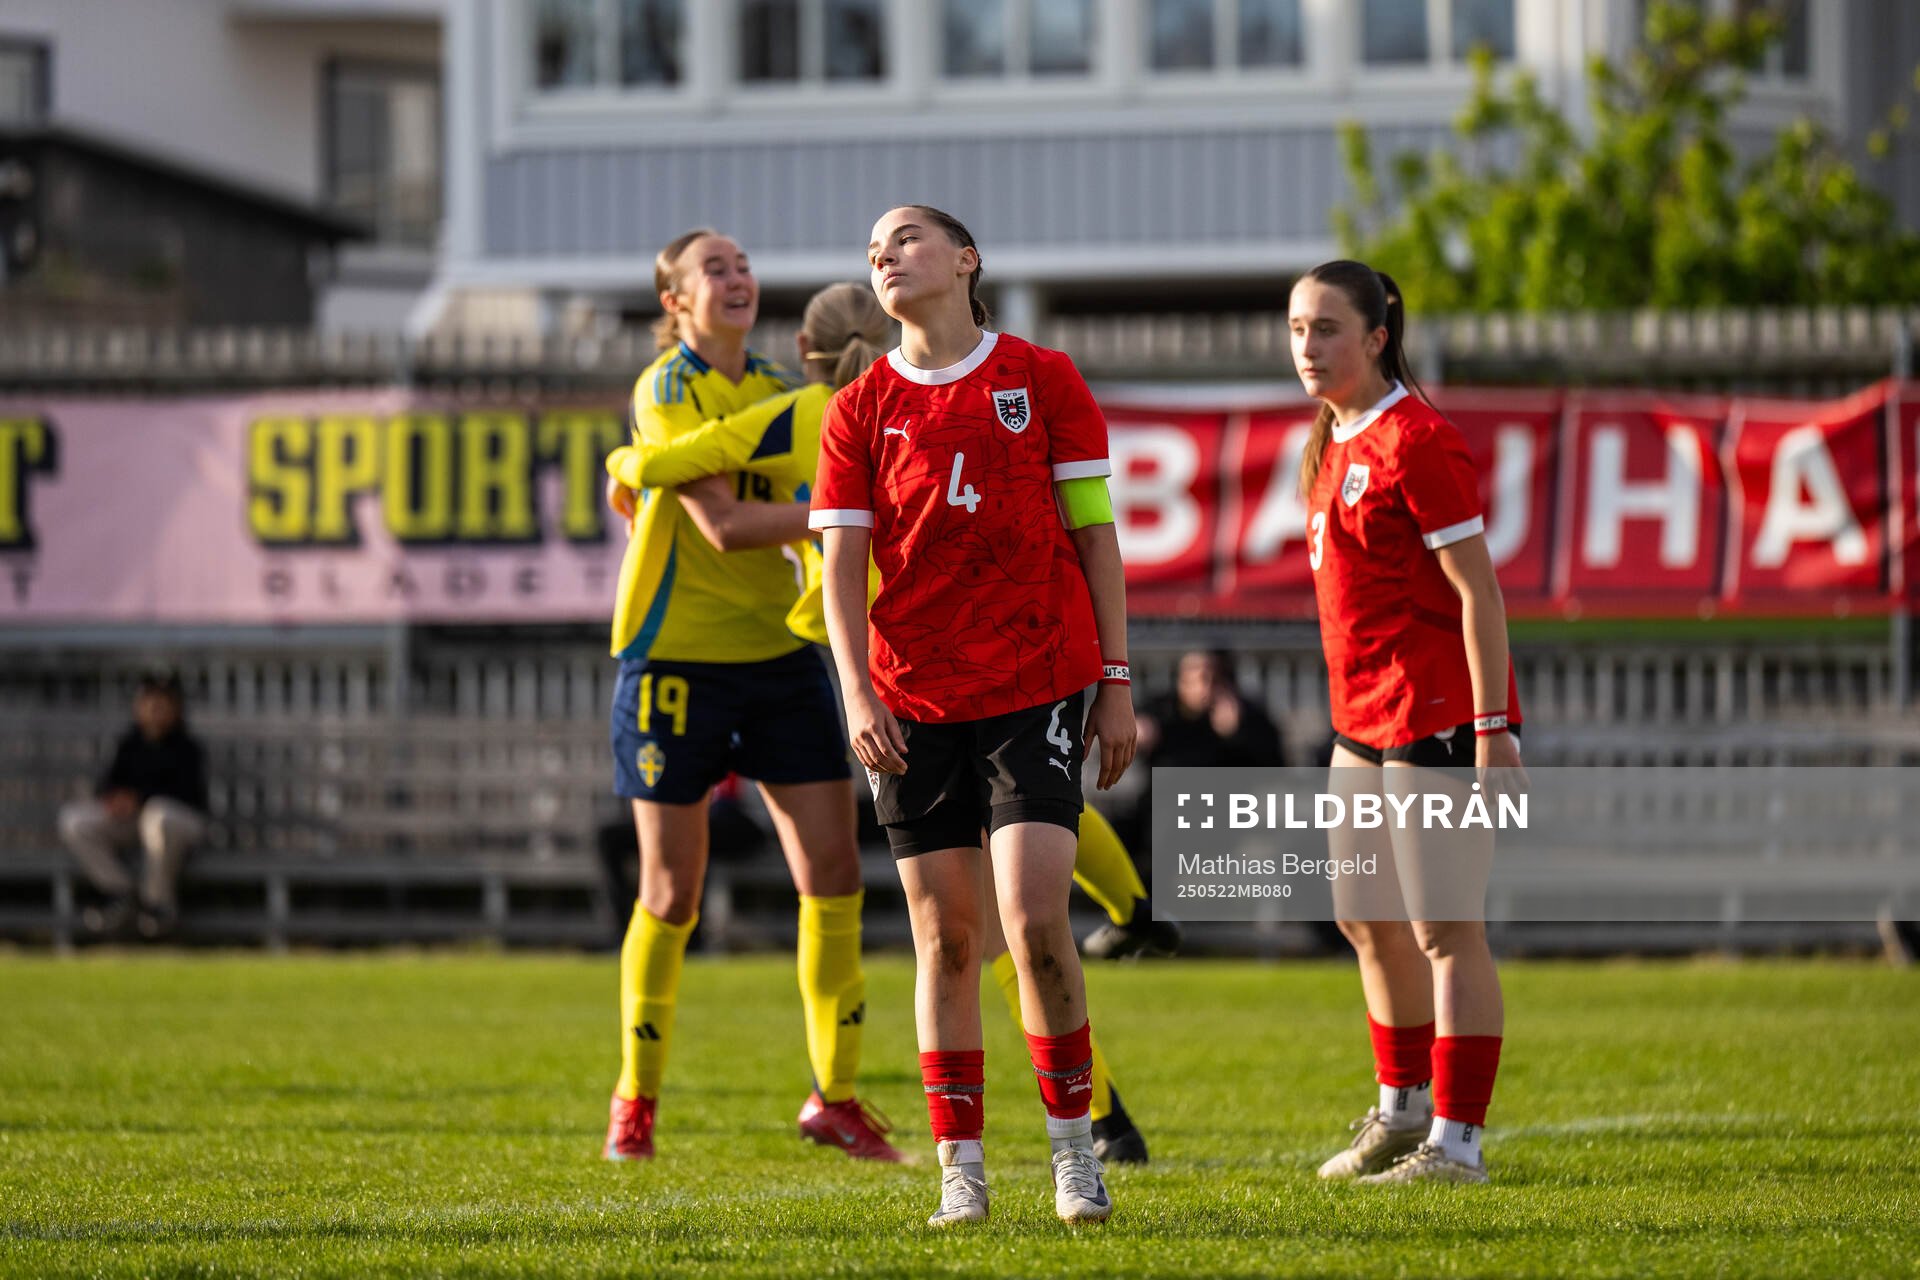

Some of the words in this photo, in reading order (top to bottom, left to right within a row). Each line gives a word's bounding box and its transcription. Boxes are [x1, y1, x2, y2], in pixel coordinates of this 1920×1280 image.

[248, 413, 621, 545] SPORT
[946, 452, 981, 513] 4
[1309, 511, 1327, 571] 3
[637, 673, 690, 736] 19
[1046, 700, 1073, 755] 4
